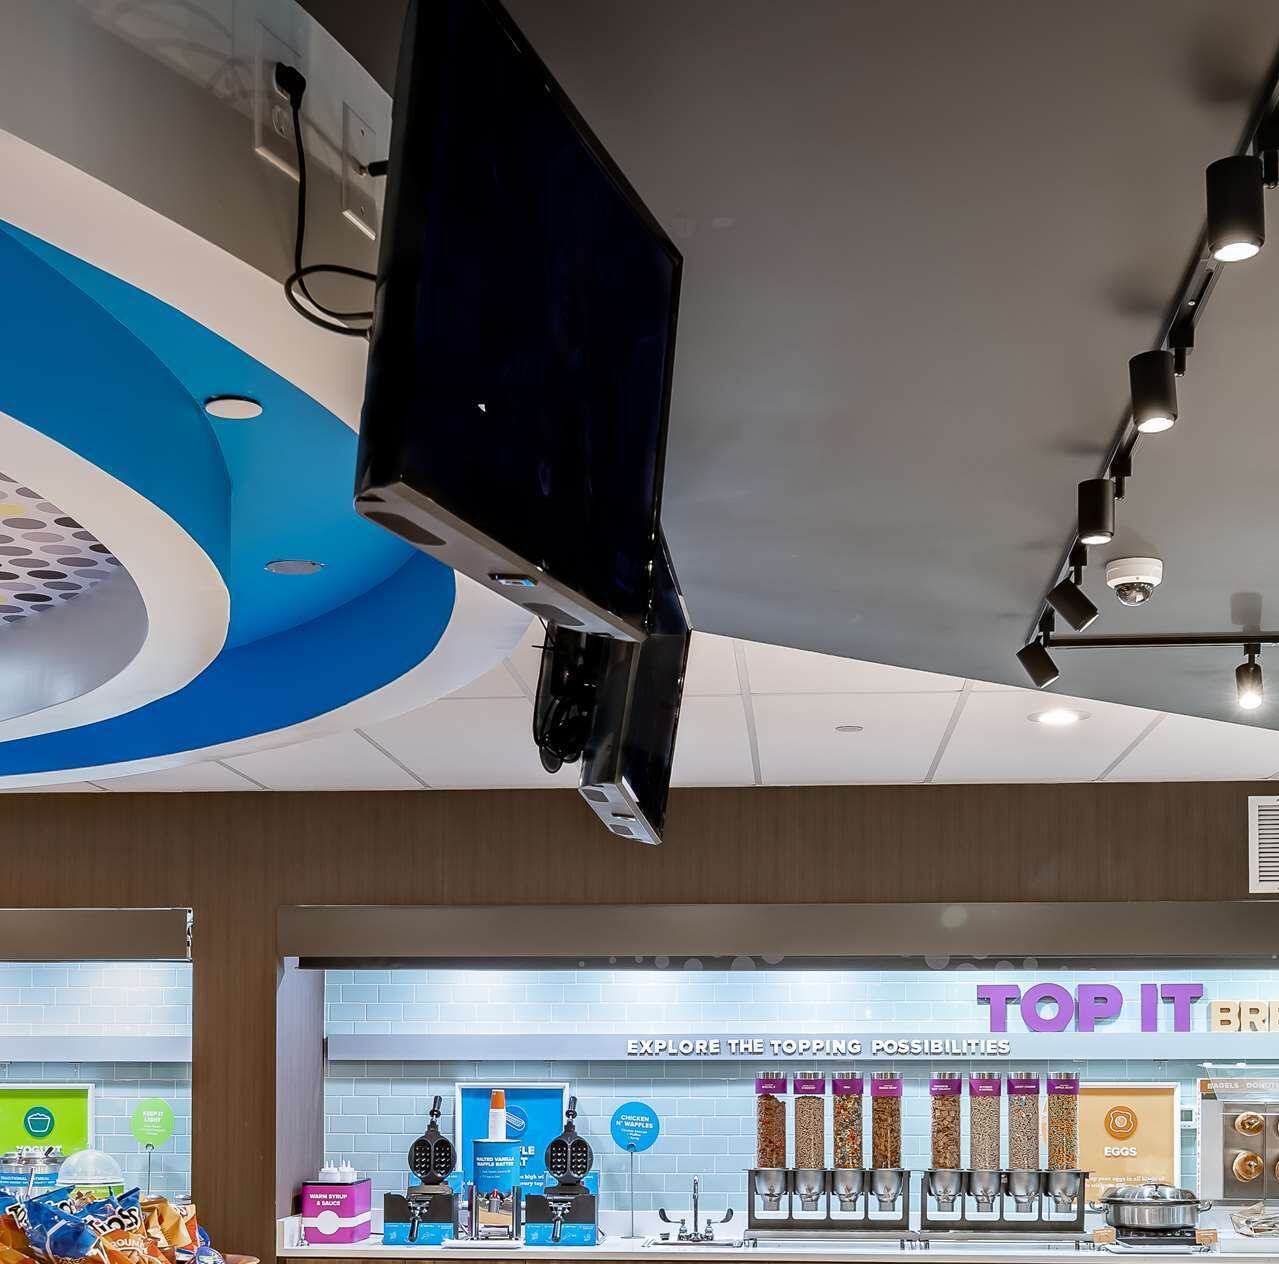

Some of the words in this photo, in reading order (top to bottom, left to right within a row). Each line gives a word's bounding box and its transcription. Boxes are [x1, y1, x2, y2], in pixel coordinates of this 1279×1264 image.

[977, 983, 1123, 1033] TOP
[1140, 982, 1203, 1033] IT
[627, 1040, 720, 1057] EXPLORE
[727, 1040, 763, 1055] THE
[770, 1040, 862, 1055] TOPPING
[871, 1040, 1010, 1056] POSSIBILITIES
[1104, 1147, 1137, 1156] EGGS
